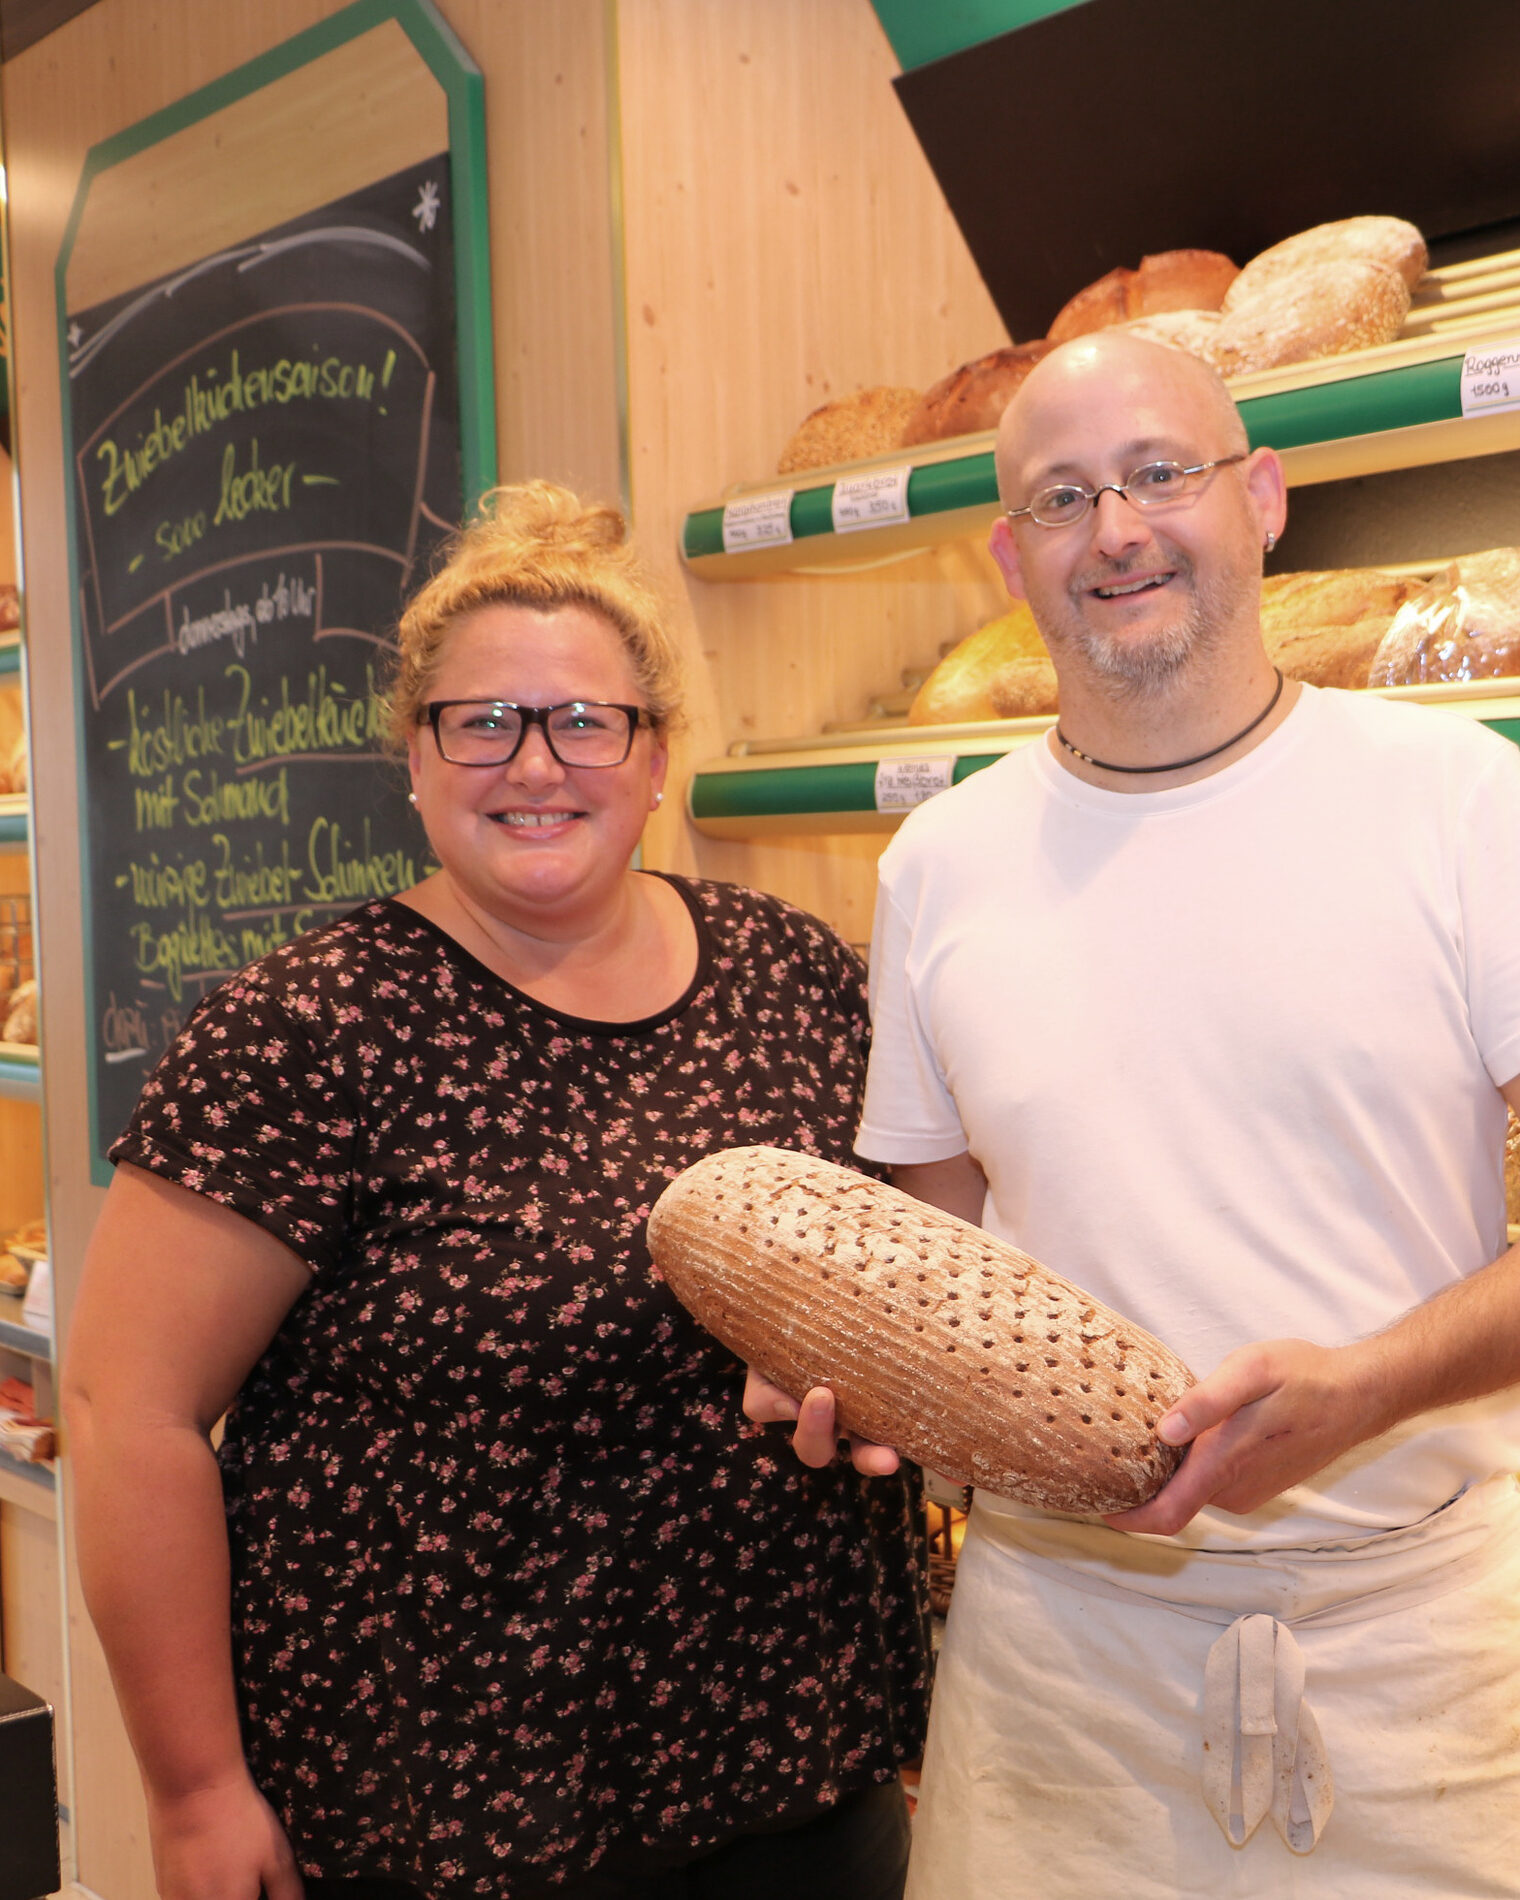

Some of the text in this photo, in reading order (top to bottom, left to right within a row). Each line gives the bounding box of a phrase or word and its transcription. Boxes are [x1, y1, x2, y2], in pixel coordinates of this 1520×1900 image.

[1465, 353, 1520, 376] Roggen
[214, 438, 295, 526] lecker
[135, 767, 289, 832] mit Schmand
